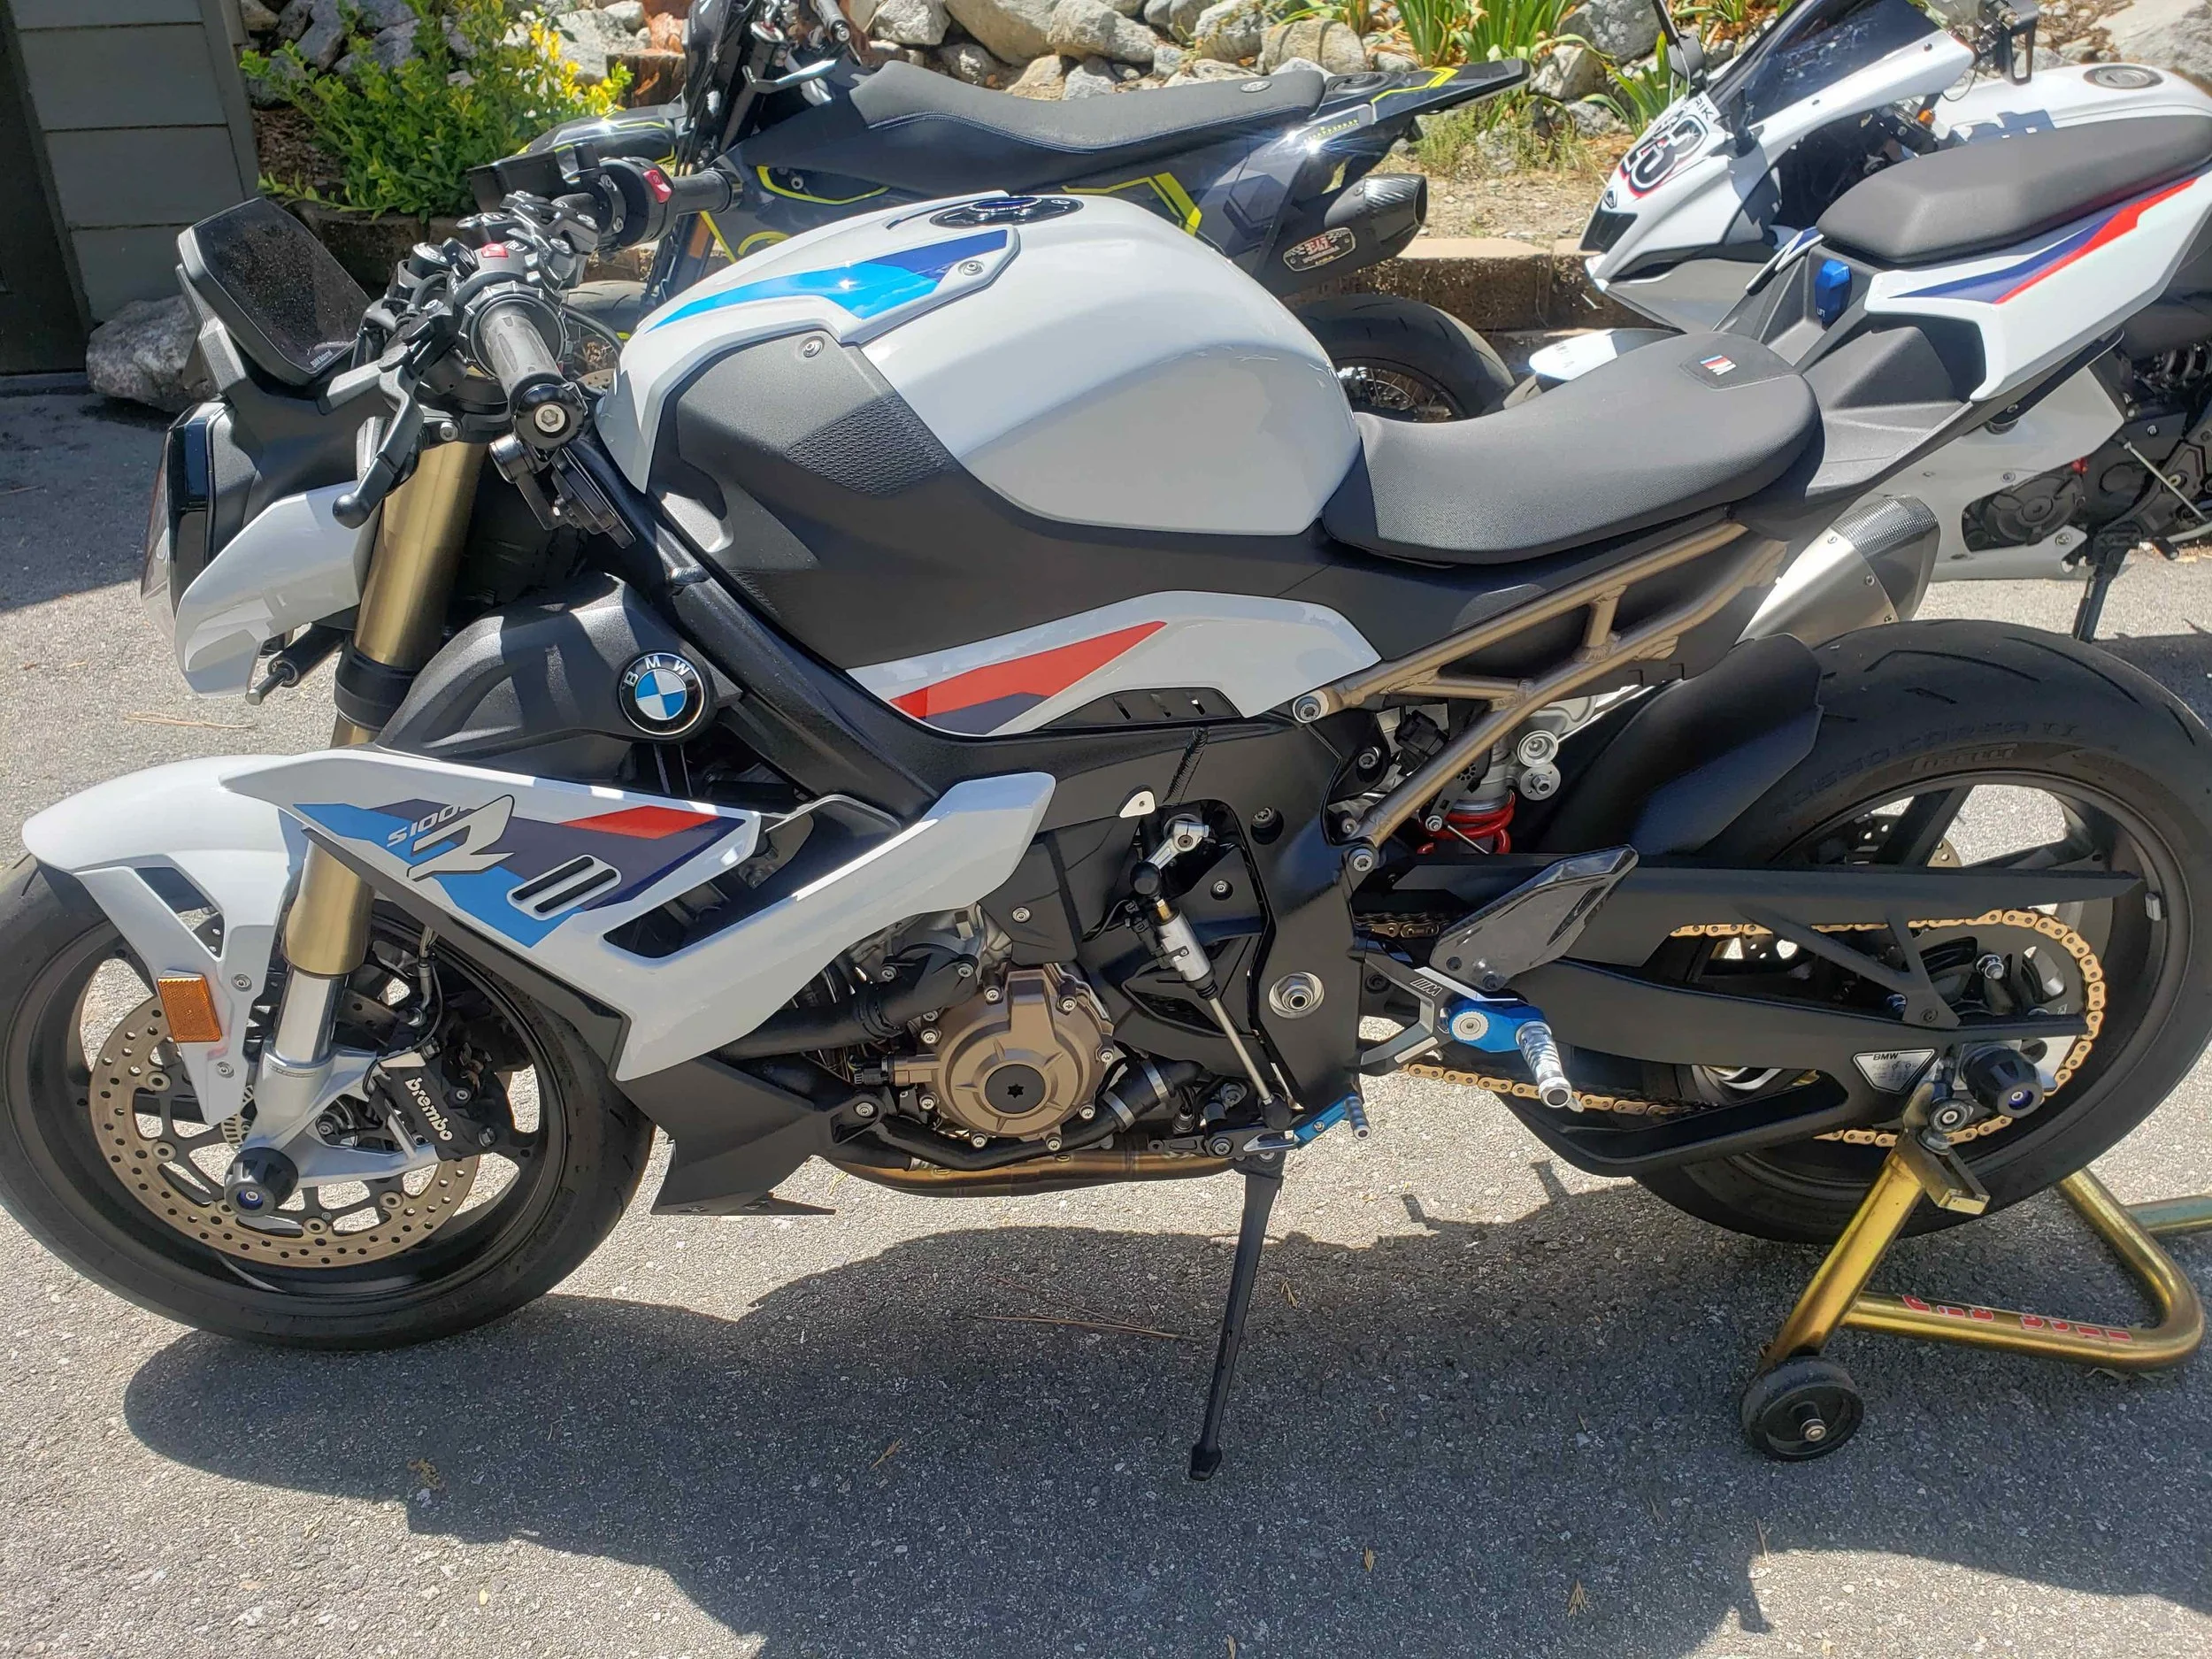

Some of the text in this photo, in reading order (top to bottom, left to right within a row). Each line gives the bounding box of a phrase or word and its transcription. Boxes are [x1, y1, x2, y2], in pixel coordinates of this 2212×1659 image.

[623, 655, 690, 687] BMW
[386, 804, 465, 849] S100
[1873, 1052, 1900, 1061] BMW
[404, 1077, 453, 1141] brembo
